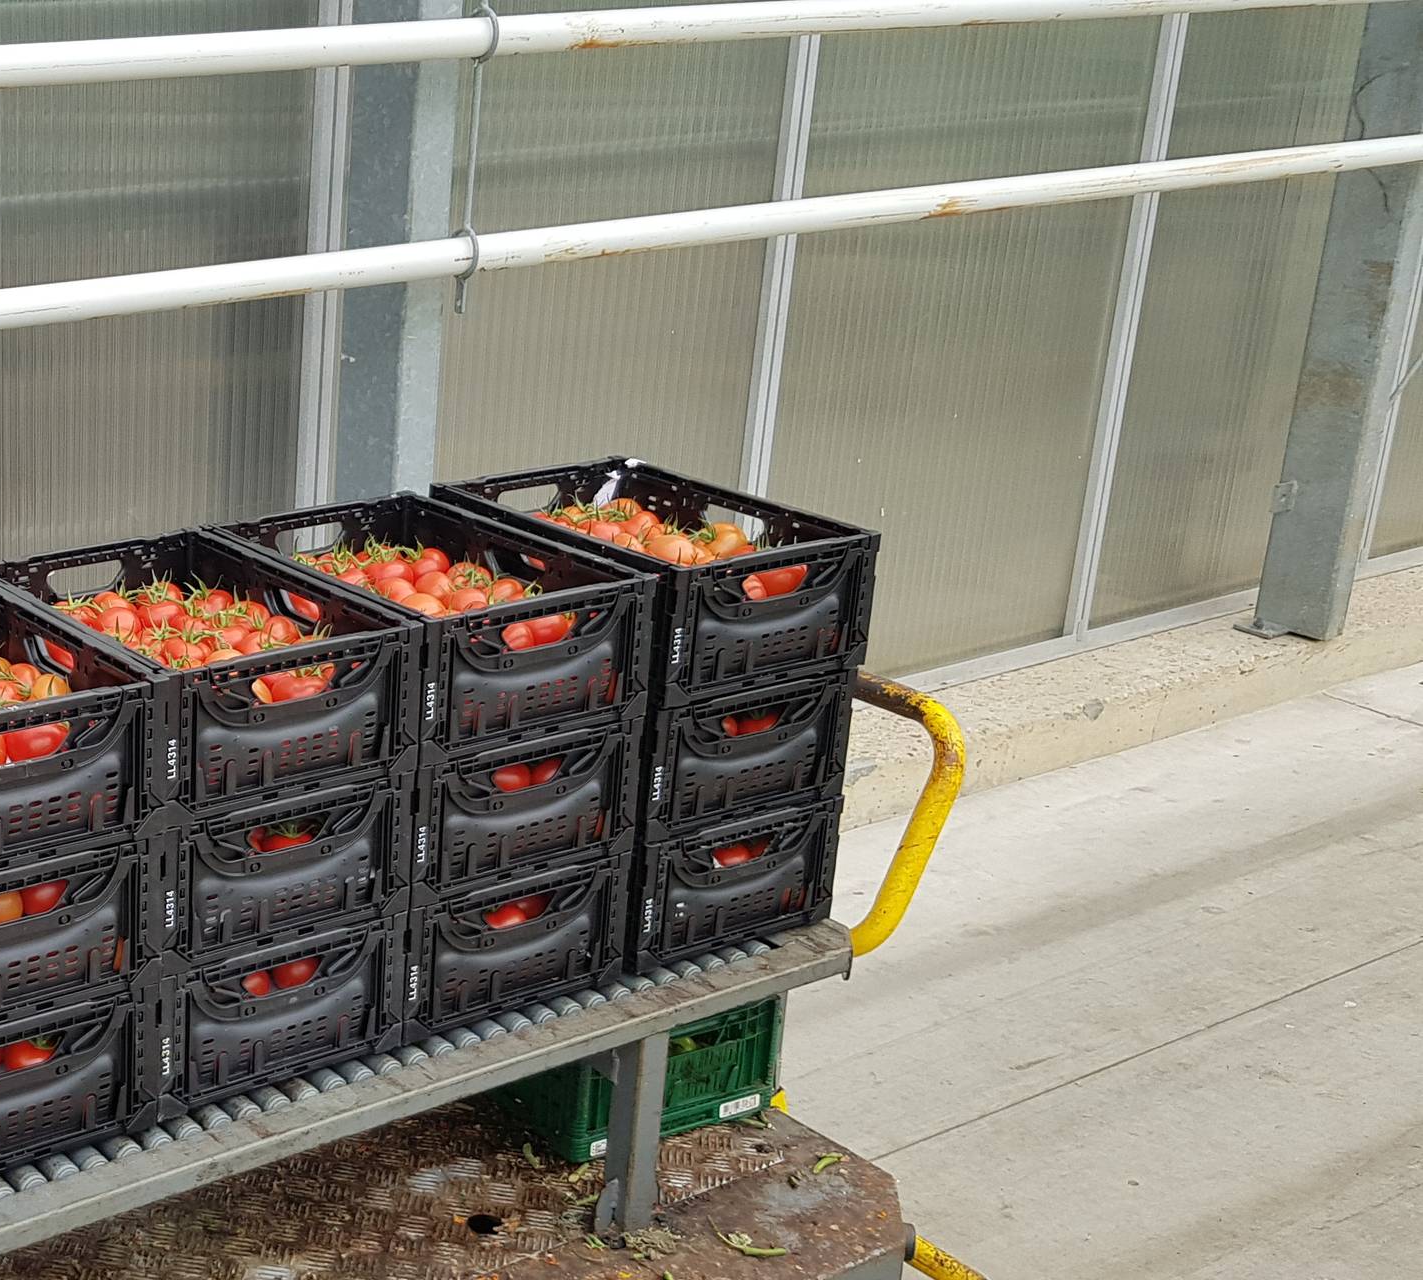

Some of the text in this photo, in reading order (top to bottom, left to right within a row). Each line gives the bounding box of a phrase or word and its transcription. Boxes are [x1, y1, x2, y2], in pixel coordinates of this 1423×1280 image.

[671, 627, 683, 664] LL4314
[425, 682, 436, 721] LL4314
[167, 739, 177, 780] LL4314
[651, 766, 663, 801] LL4314
[416, 826, 427, 863] LL4314
[165, 890, 175, 928] LL4314
[643, 898, 653, 933] LL4314
[408, 965, 419, 1001] LL4314
[161, 1037, 170, 1076] LL4314
